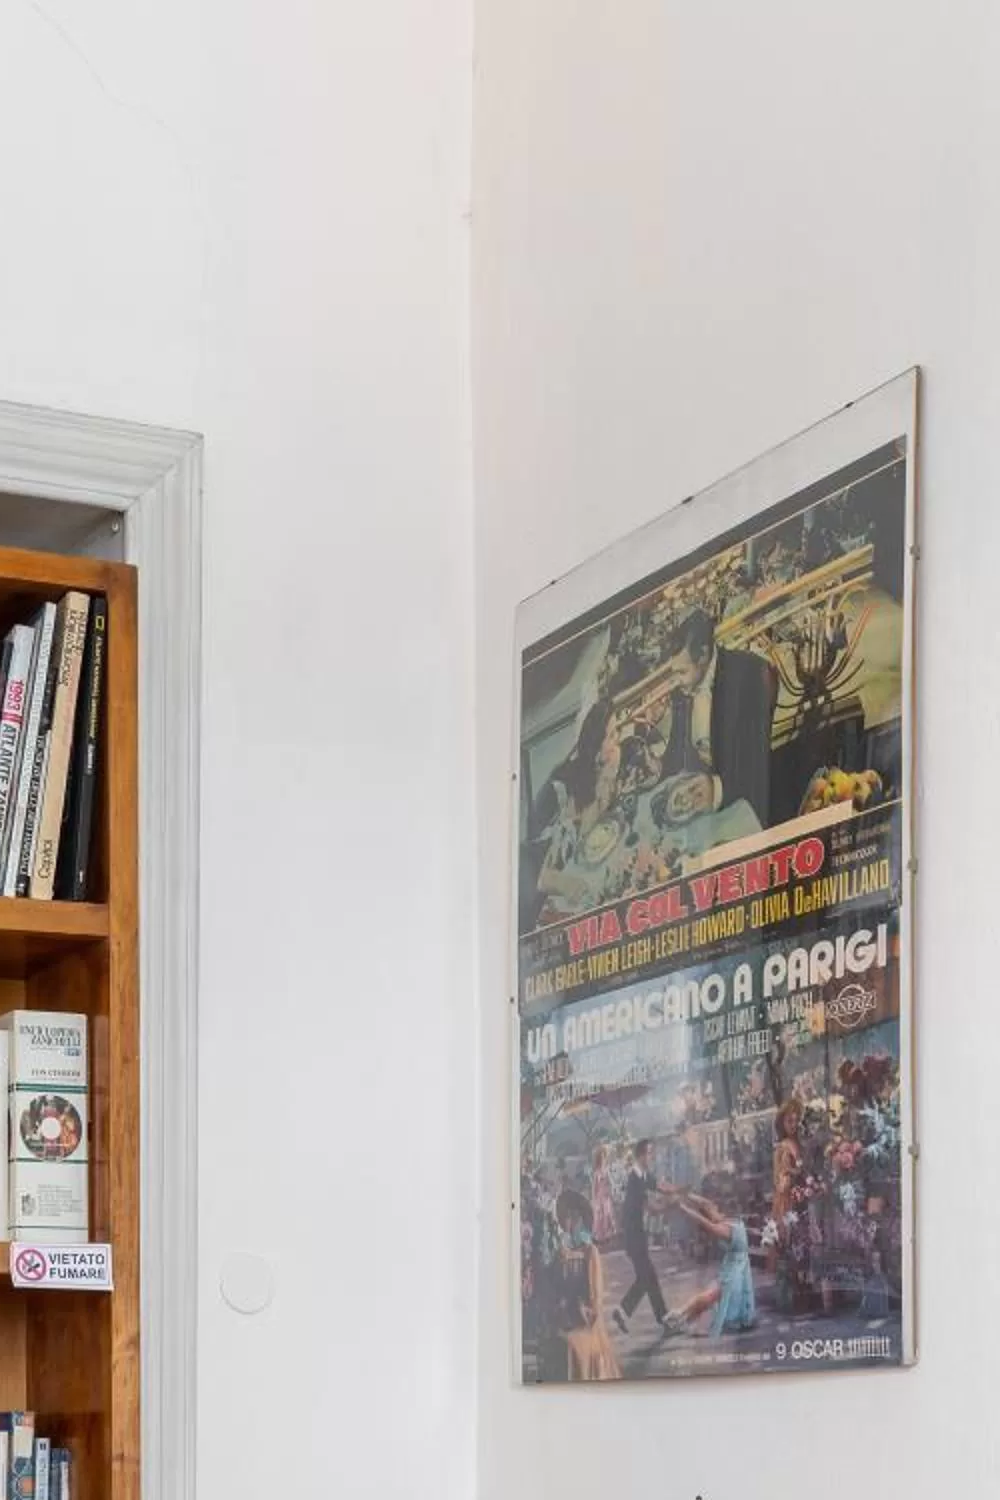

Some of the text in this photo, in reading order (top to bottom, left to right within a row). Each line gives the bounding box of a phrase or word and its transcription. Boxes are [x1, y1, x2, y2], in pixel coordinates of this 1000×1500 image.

[6, 677, 25, 711] 1993
[565, 909, 623, 956] VIA
[627, 886, 689, 936] COL
[689, 837, 825, 912] VENTO
[655, 923, 690, 959] LESLIE
[691, 906, 745, 947] HOWARD
[751, 891, 790, 929] OLIVIA
[563, 973, 726, 1053] AMERICANO
[733, 962, 753, 1006] A
[763, 923, 887, 997] PARIGI
[49, 1253, 105, 1267] VIETATO
[49, 1267, 106, 1280] FUMARE
[776, 1342, 786, 1360] 9
[791, 1338, 844, 1360] OSCAR
